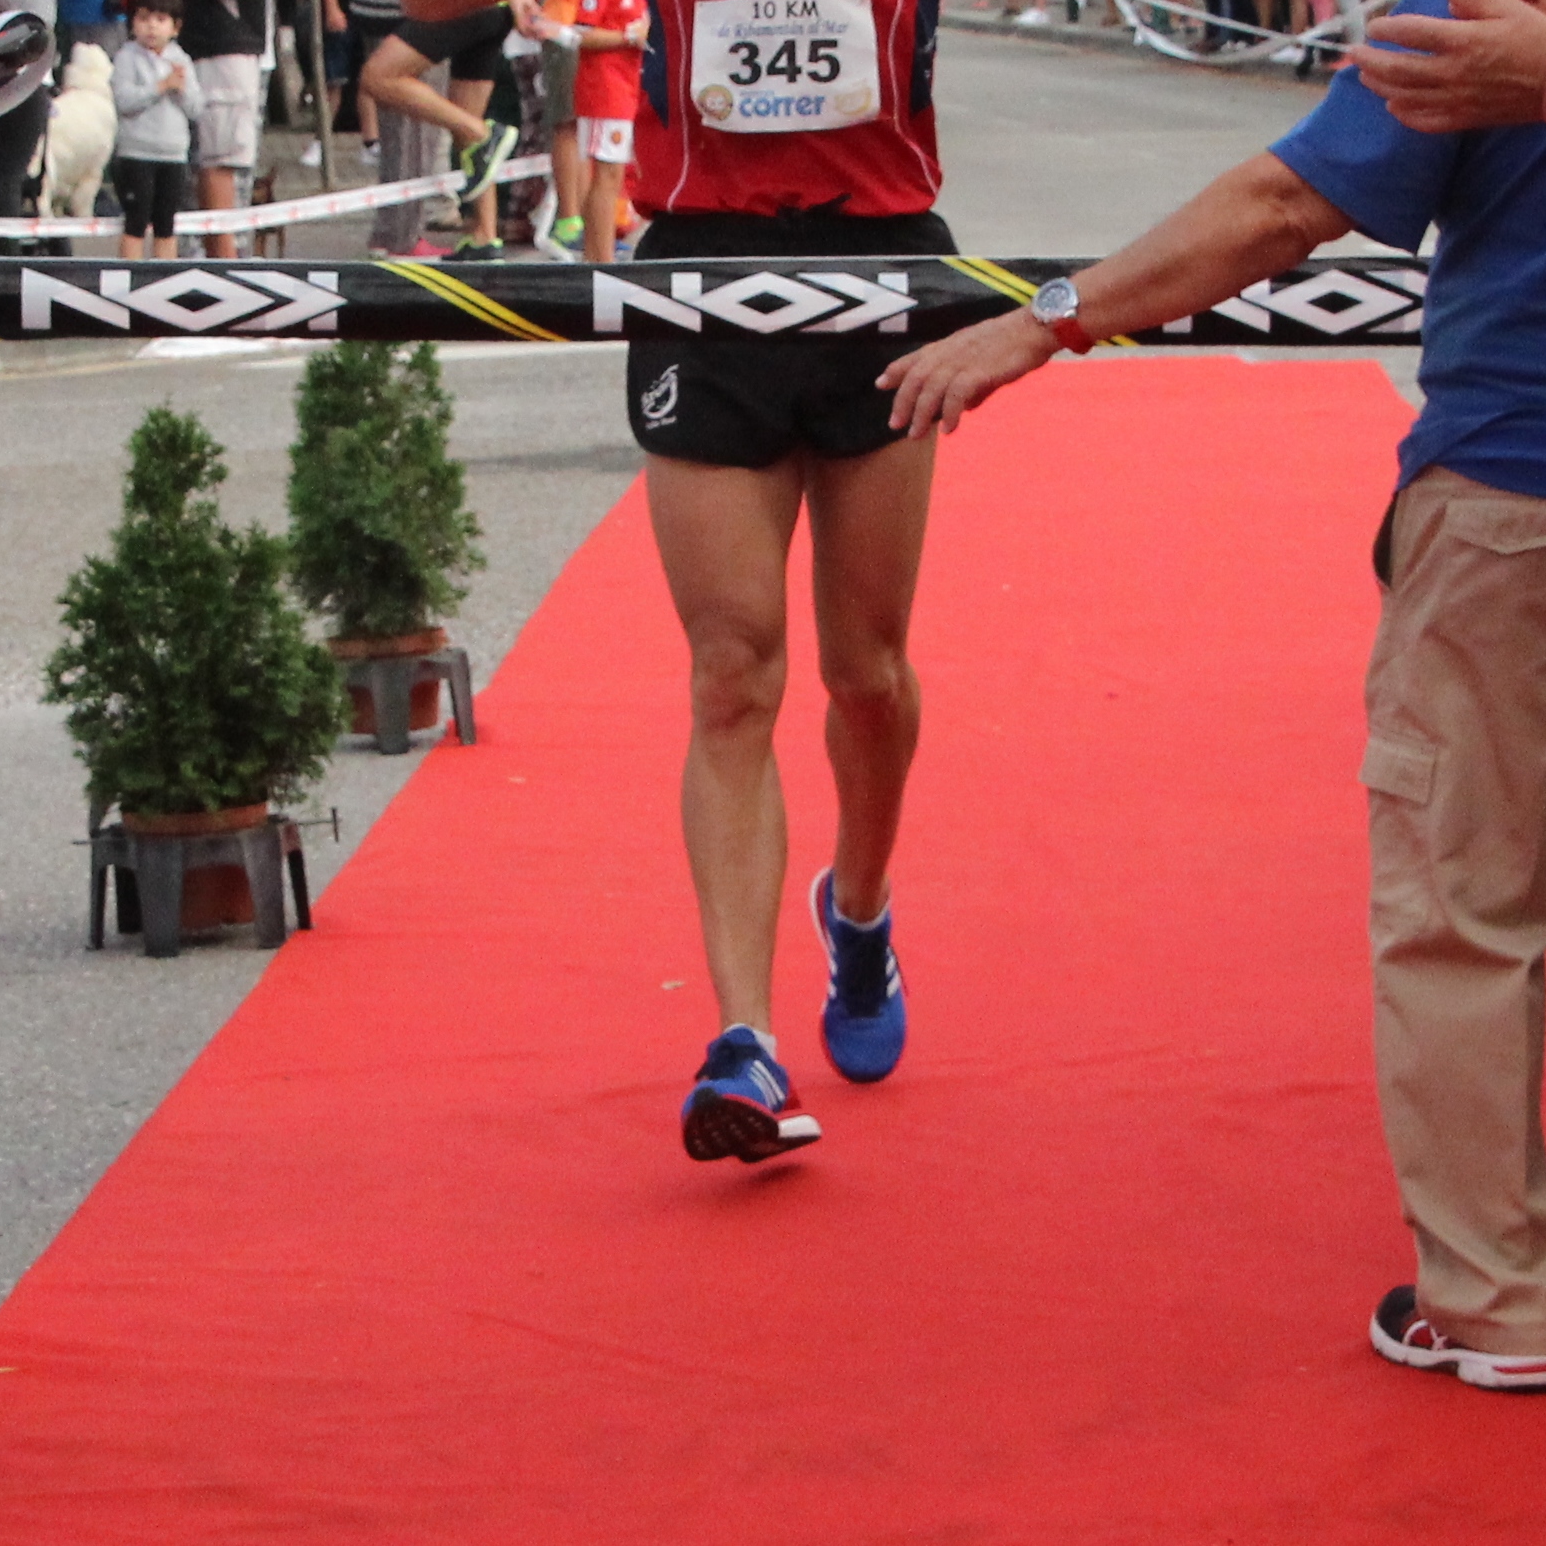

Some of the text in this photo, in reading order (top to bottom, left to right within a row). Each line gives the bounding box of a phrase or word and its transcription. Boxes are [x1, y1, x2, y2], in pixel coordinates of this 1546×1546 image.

[753, 0, 819, 19] 10 KM
[729, 39, 841, 86] 345
[738, 95, 826, 118] correr
